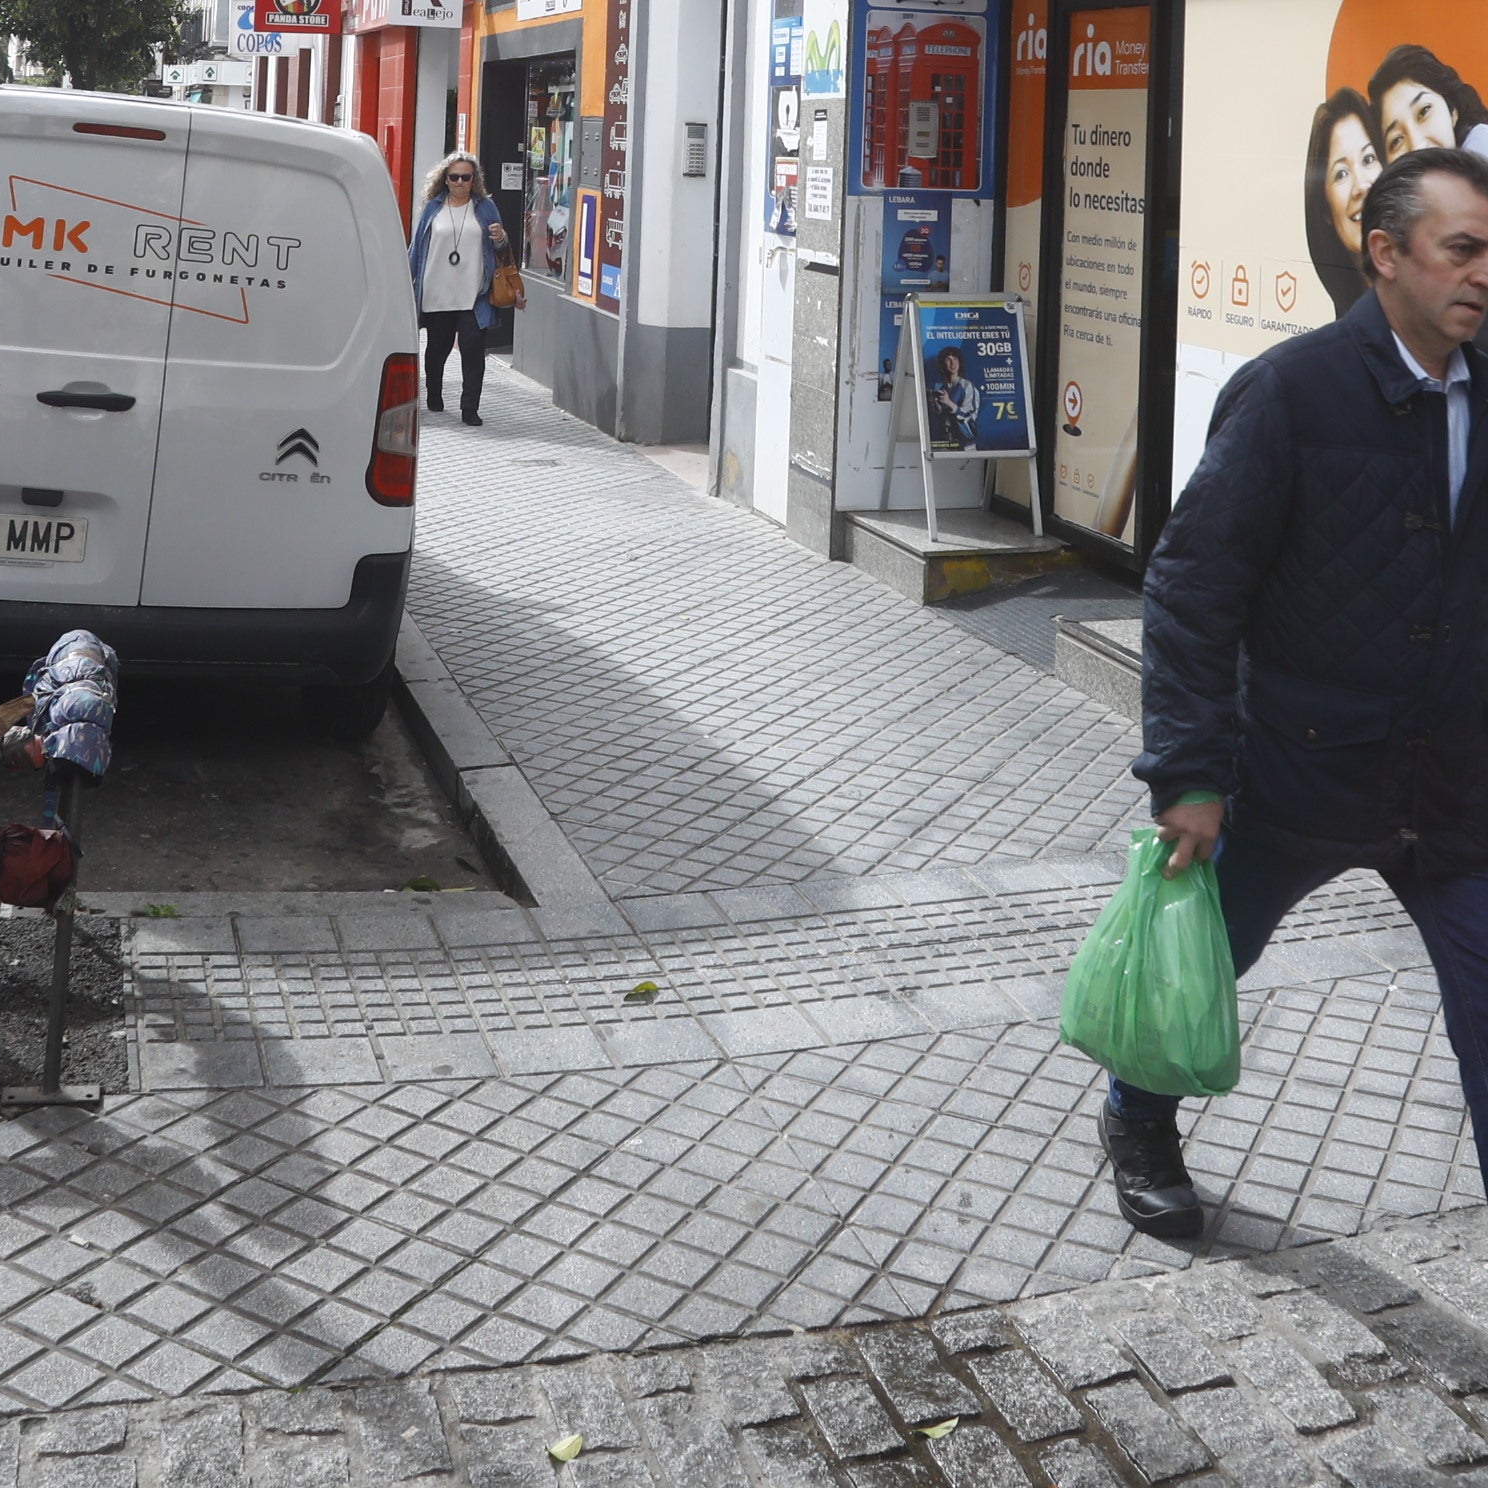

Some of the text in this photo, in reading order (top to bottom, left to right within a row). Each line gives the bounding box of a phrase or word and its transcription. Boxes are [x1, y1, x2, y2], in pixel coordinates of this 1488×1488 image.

[268, 14, 326, 26] PANDA STORE
[237, 32, 282, 53] COPOS
[1017, 13, 1047, 61] ria
[927, 45, 968, 56] TELEPHONE
[1073, 24, 1112, 76] ria
[1116, 41, 1146, 56] Money
[1072, 124, 1131, 147] Tu dinero
[1070, 156, 1110, 178] donde
[889, 196, 915, 204] LEBARA
[1069, 187, 1145, 214] lo necesitas
[133, 224, 302, 270] RENT
[1067, 231, 1137, 251] Con medio millón de
[87, 264, 114, 275] DE
[130, 267, 287, 289] FURGONETAS
[1066, 257, 1134, 276] ubicaciones en todo
[1065, 279, 1127, 300] el mundo, siempre
[885, 301, 904, 309] LEBA
[1064, 303, 1142, 328] encontrarás una oficina
[1188, 306, 1212, 320] RÁPIDO
[1225, 313, 1254, 327] SEGURO
[927, 332, 935, 340] EL
[937, 332, 980, 340] INTELIGENTE
[1001, 330, 1010, 339] TÚ
[1063, 324, 1074, 337] Ria
[1076, 329, 1094, 343] cerca
[1096, 332, 1104, 344] de
[7, 519, 75, 554] MMP
